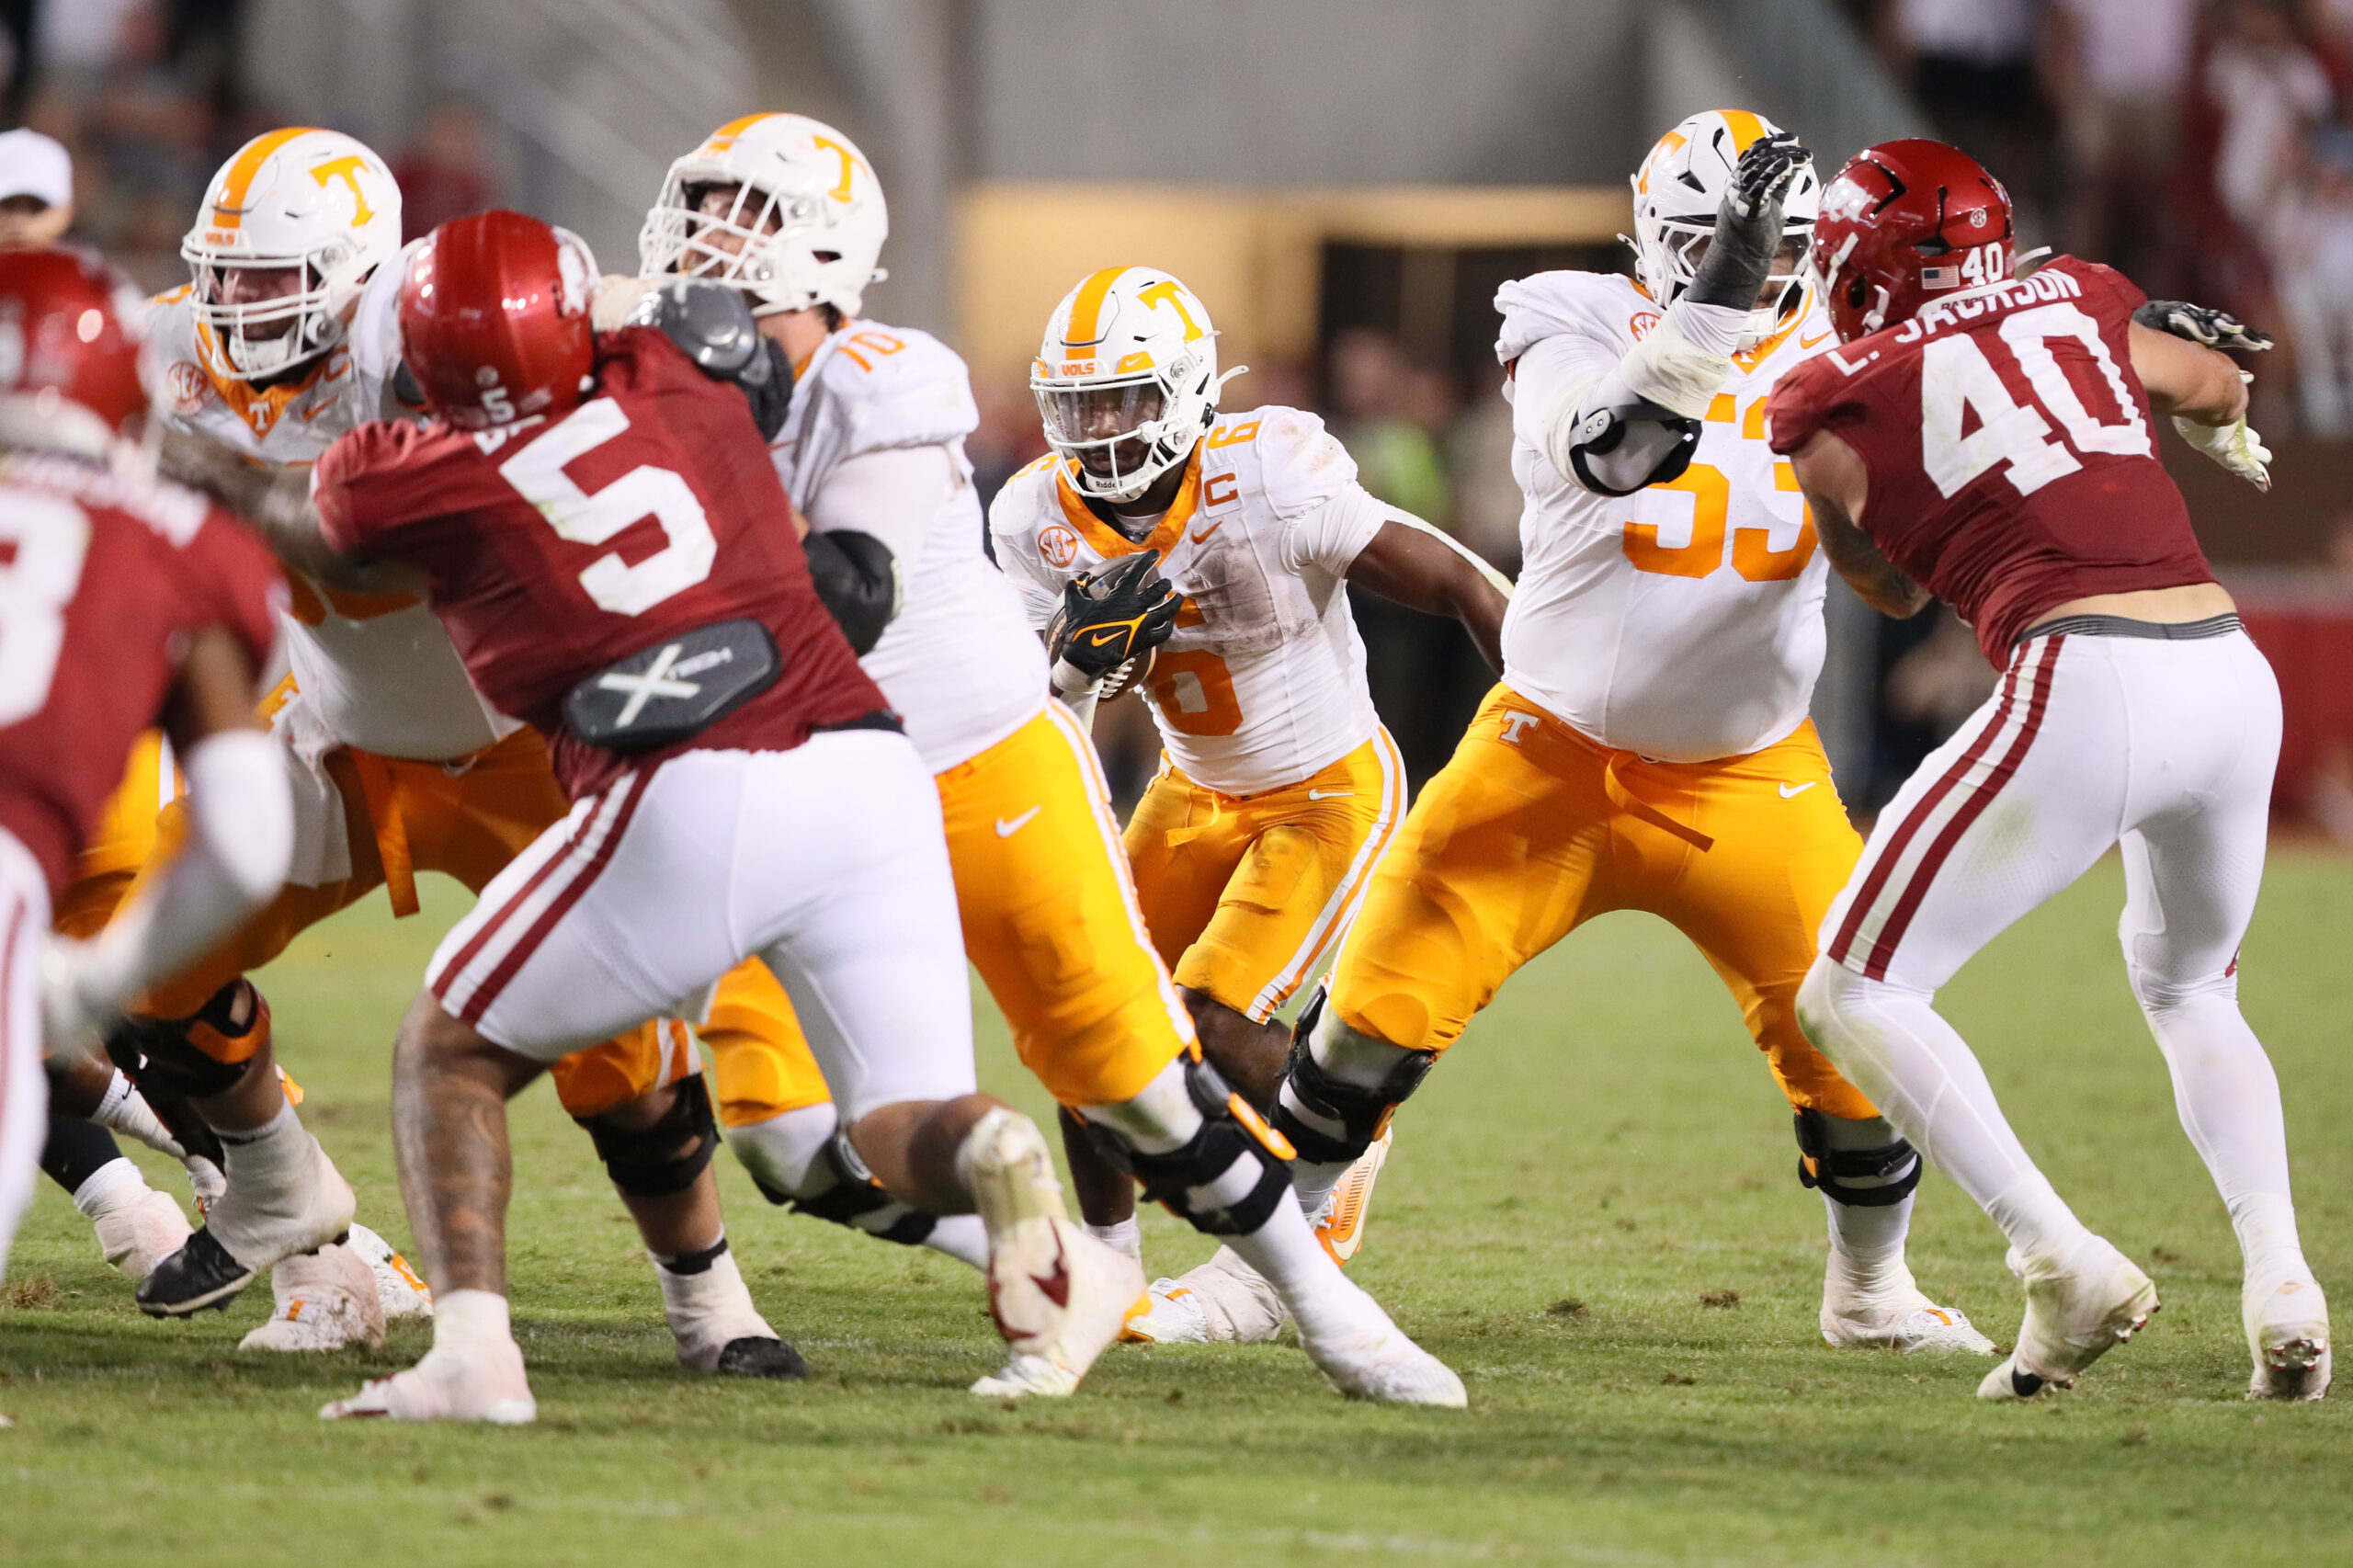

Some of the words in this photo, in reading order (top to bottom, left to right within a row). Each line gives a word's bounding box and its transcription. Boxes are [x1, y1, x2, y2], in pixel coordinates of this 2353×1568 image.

[813, 133, 870, 203] T
[309, 154, 375, 227] T
[1961, 242, 2004, 286] 40
[1137, 279, 1203, 343] T
[1062, 362, 1096, 376] VOLS
[1826, 350, 1880, 377] L.
[249, 402, 270, 430] T
[482, 386, 516, 423] 5
[1922, 301, 2154, 499] 40
[1207, 420, 1262, 449] 6
[1096, 481, 1122, 489] Riddel
[1204, 472, 1238, 507] C
[499, 397, 718, 617] 5
[1039, 527, 1077, 567] SEC
[1500, 710, 1540, 744] T
